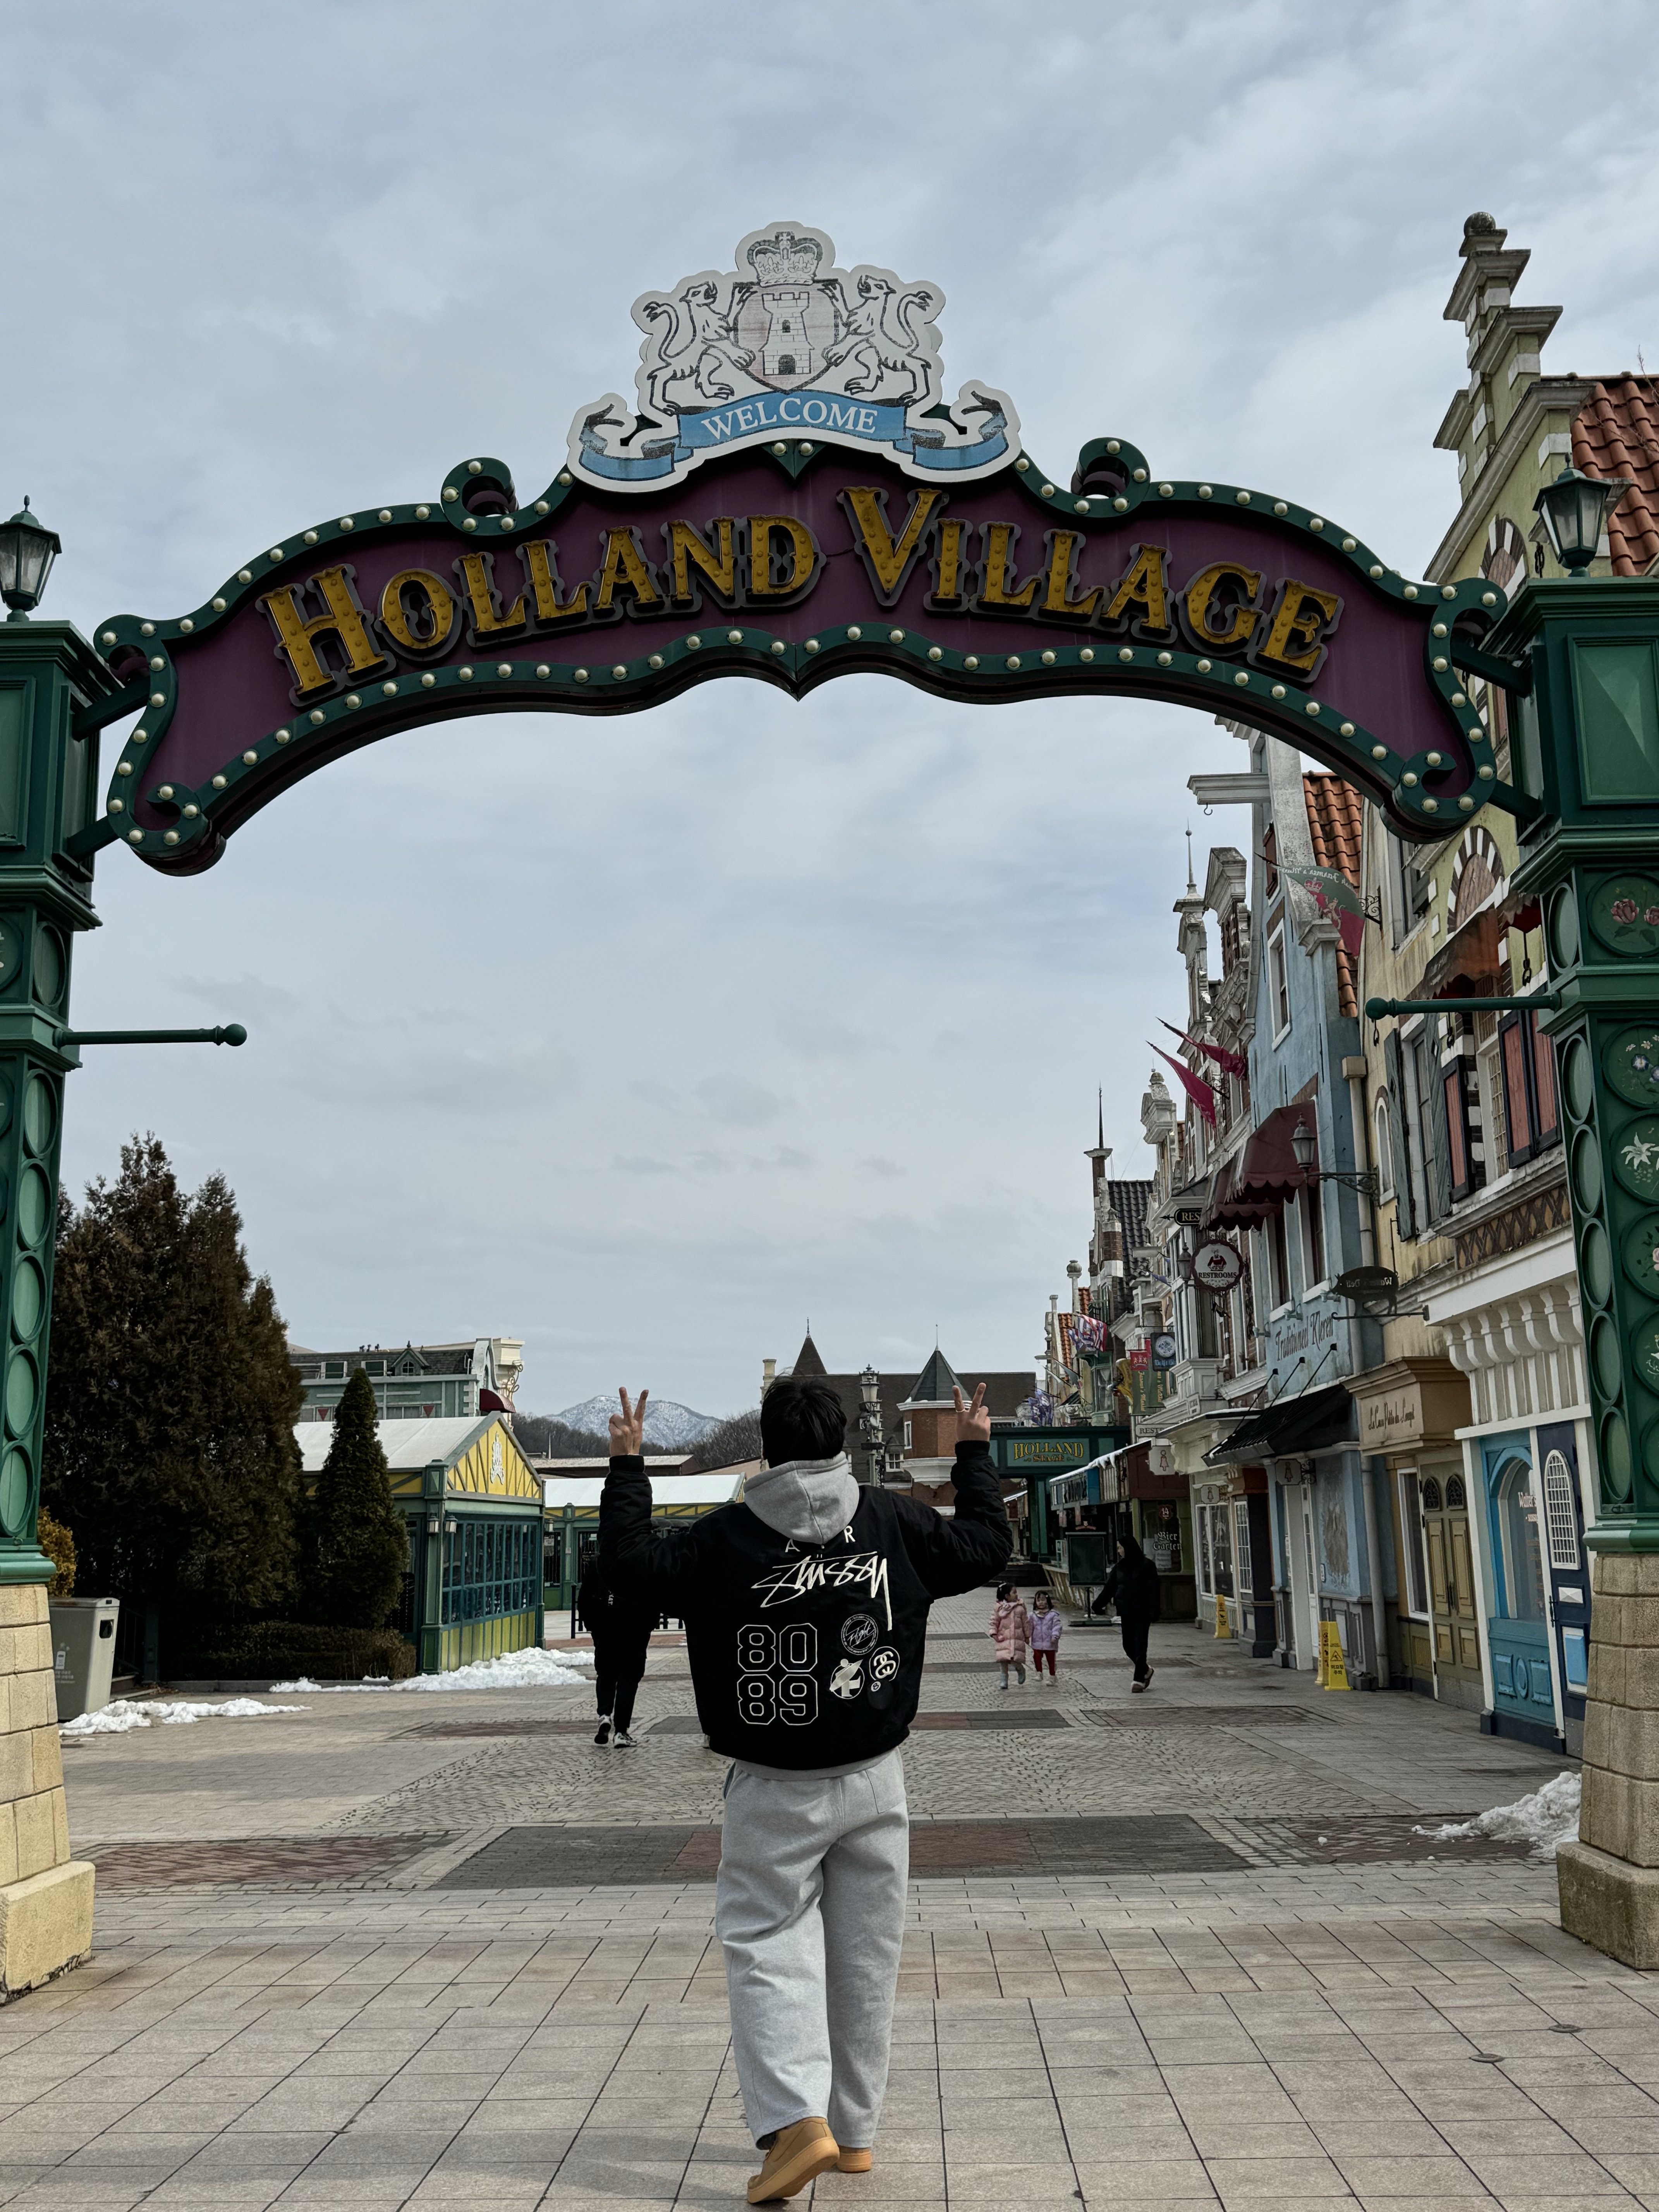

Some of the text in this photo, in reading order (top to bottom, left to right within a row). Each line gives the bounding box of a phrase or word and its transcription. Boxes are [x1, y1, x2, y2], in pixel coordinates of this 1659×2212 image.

[701, 397, 878, 439] WELCOME
[259, 485, 1342, 698] HOLLAND VILLAGE
[1182, 1212, 1201, 1221] RES
[1013, 1442, 1084, 1460] HOLLAND
[1153, 1541, 1182, 1551] Garten
[1158, 1531, 1178, 1541] Bier
[737, 1623, 818, 1672] 80
[737, 1673, 819, 1726] 89
